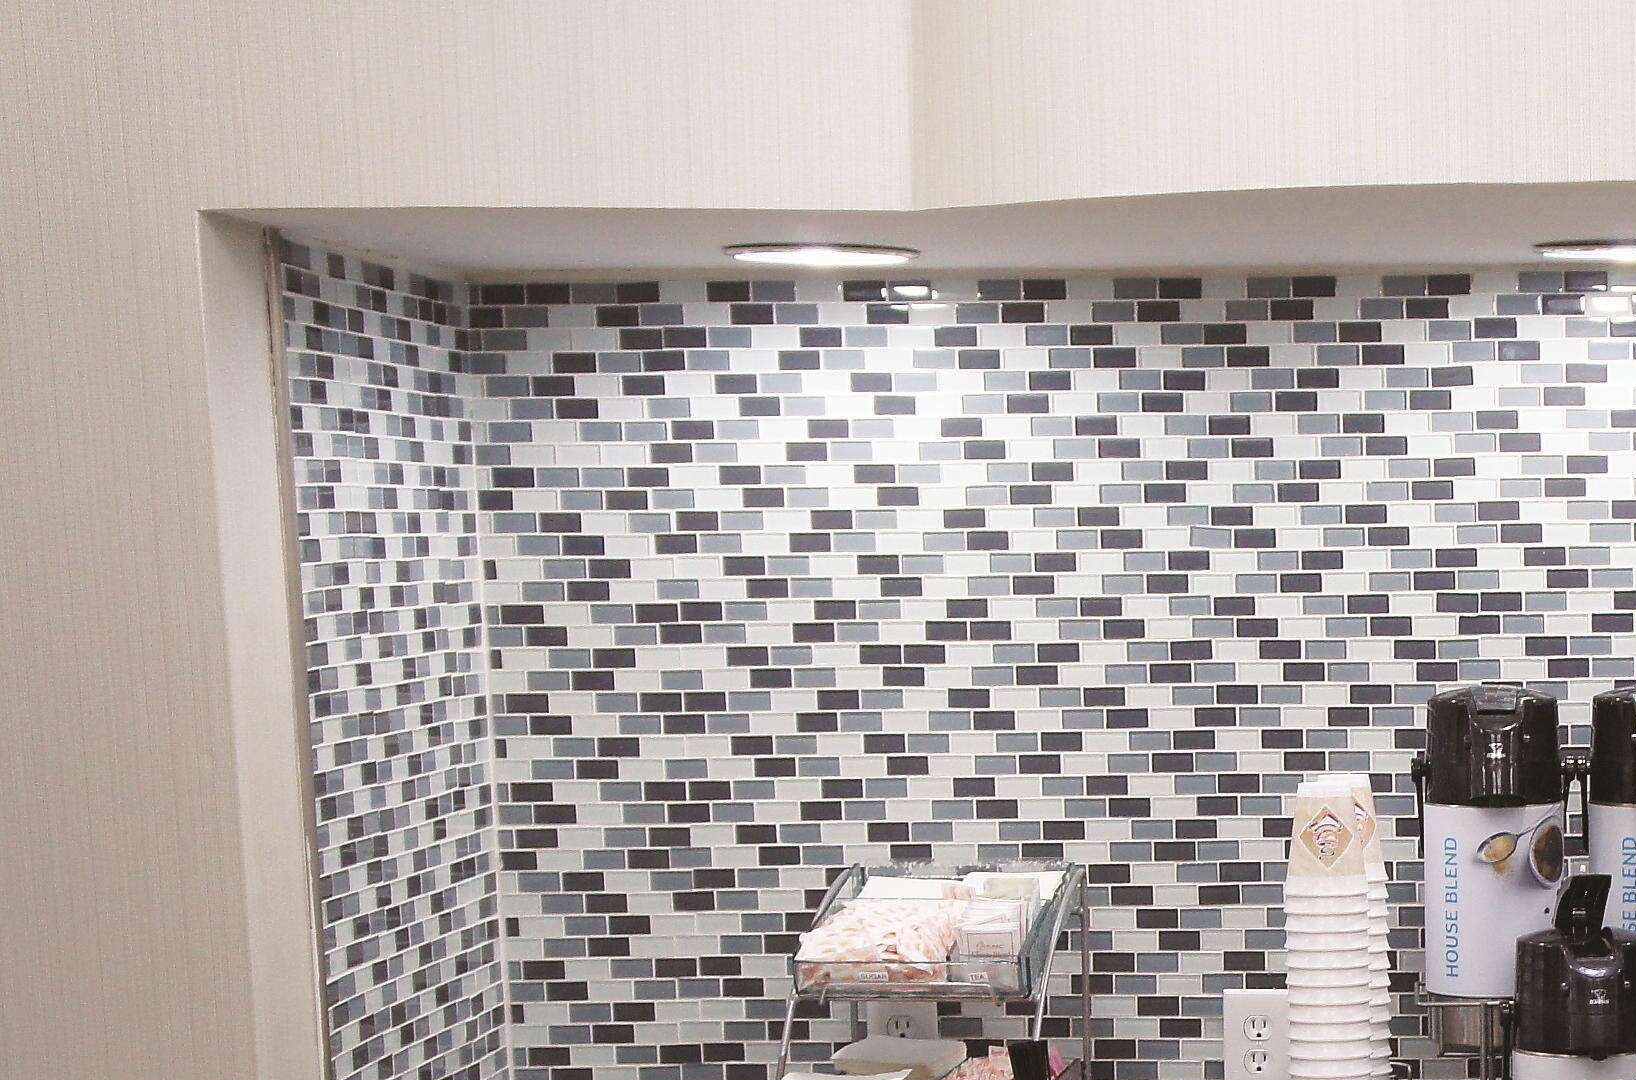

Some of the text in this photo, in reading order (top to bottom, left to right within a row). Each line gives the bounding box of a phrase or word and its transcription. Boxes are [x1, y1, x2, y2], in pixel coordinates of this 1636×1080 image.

[1444, 837, 1458, 978] HOUSE BLEND
[1622, 836, 1636, 904] BLEND
